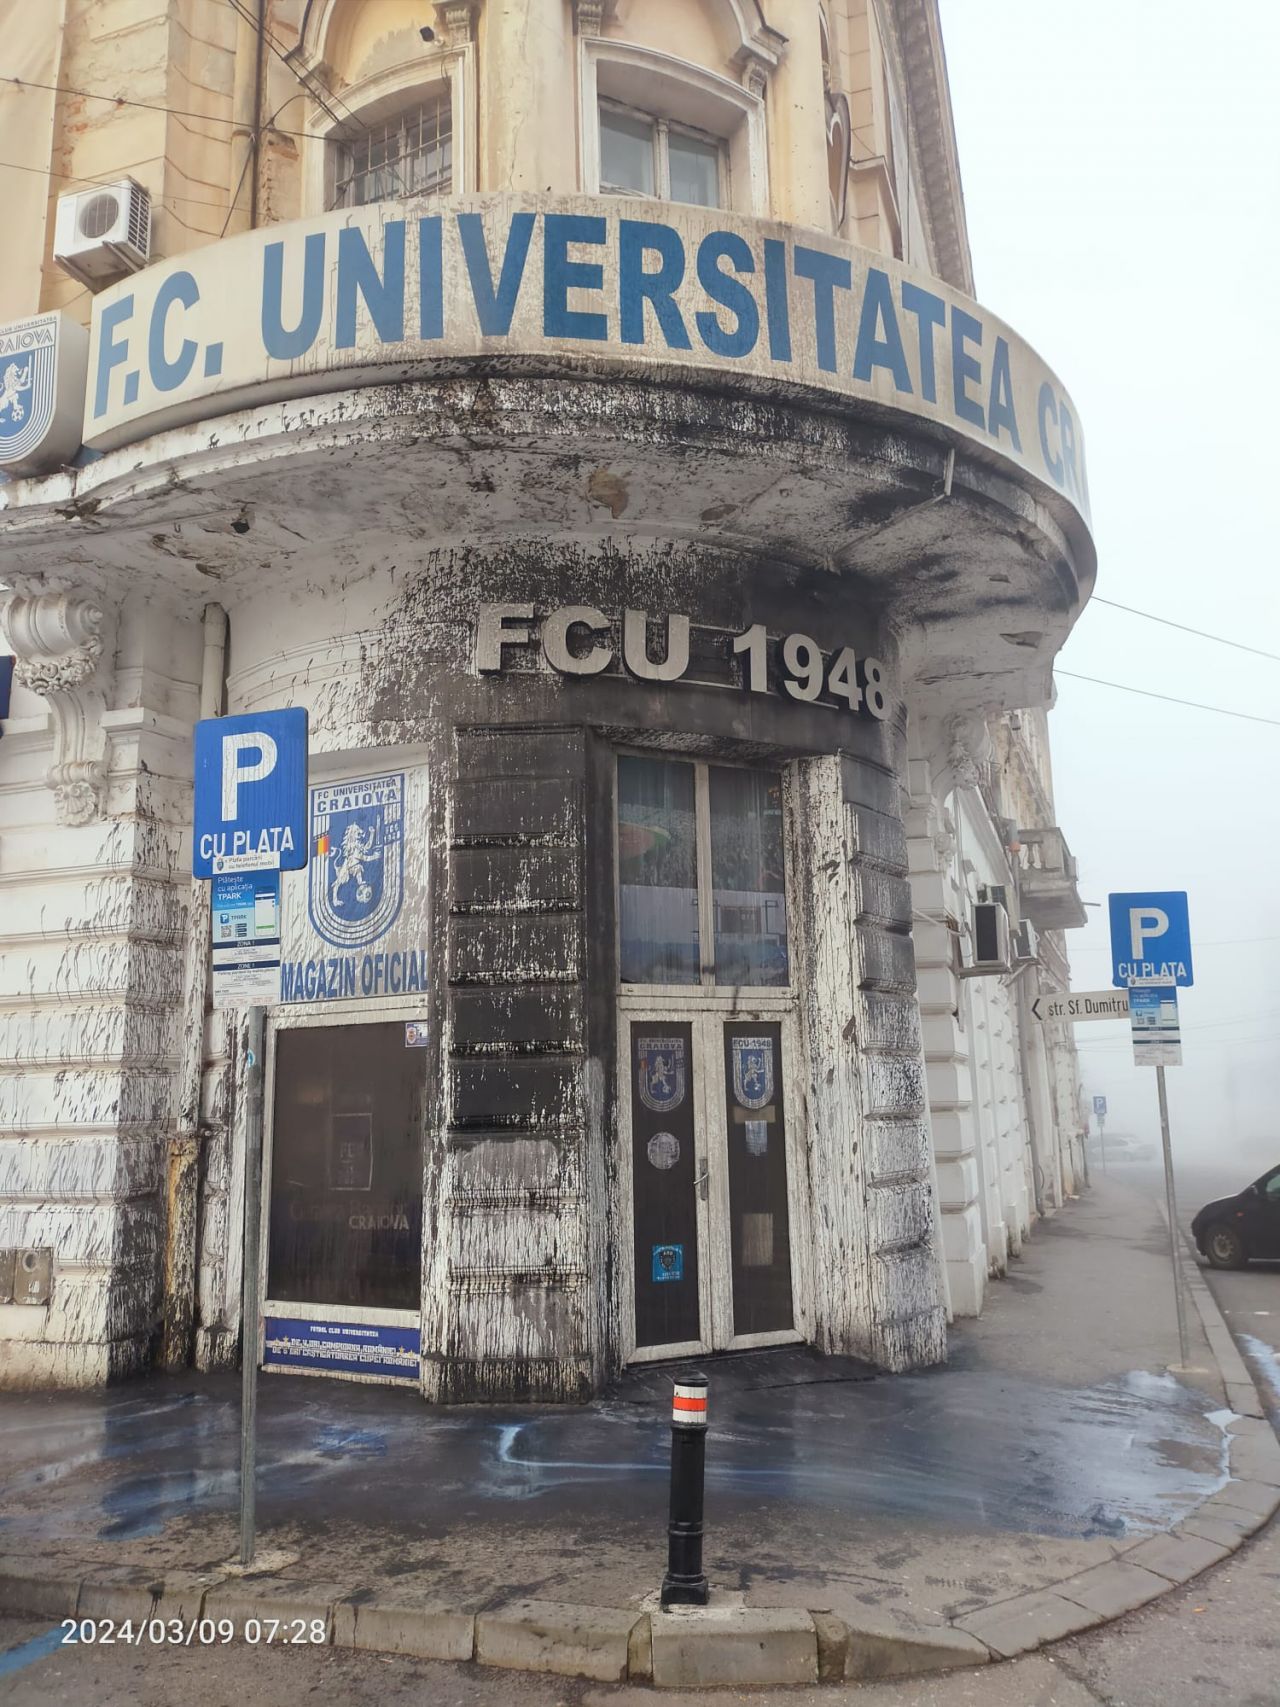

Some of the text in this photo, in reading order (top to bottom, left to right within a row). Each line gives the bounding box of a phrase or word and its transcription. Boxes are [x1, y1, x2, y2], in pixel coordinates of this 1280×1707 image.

[93, 270, 223, 419] F.C.
[262, 212, 1023, 456] UNIVERSITATEA
[477, 602, 893, 720] FCU 1948
[221, 731, 278, 822] P
[317, 777, 397, 800] FC UNIVERSITATEA
[317, 788, 397, 813] CRAIOVA
[200, 826, 295, 860] CU PLATA
[217, 892, 242, 901] TPARK
[1129, 907, 1169, 960] P
[280, 950, 428, 1002] MAGAZIN OFICIAL
[1118, 962, 1187, 978] CU PLATA
[1048, 997, 1129, 1016] str. Sf. Dumitru
